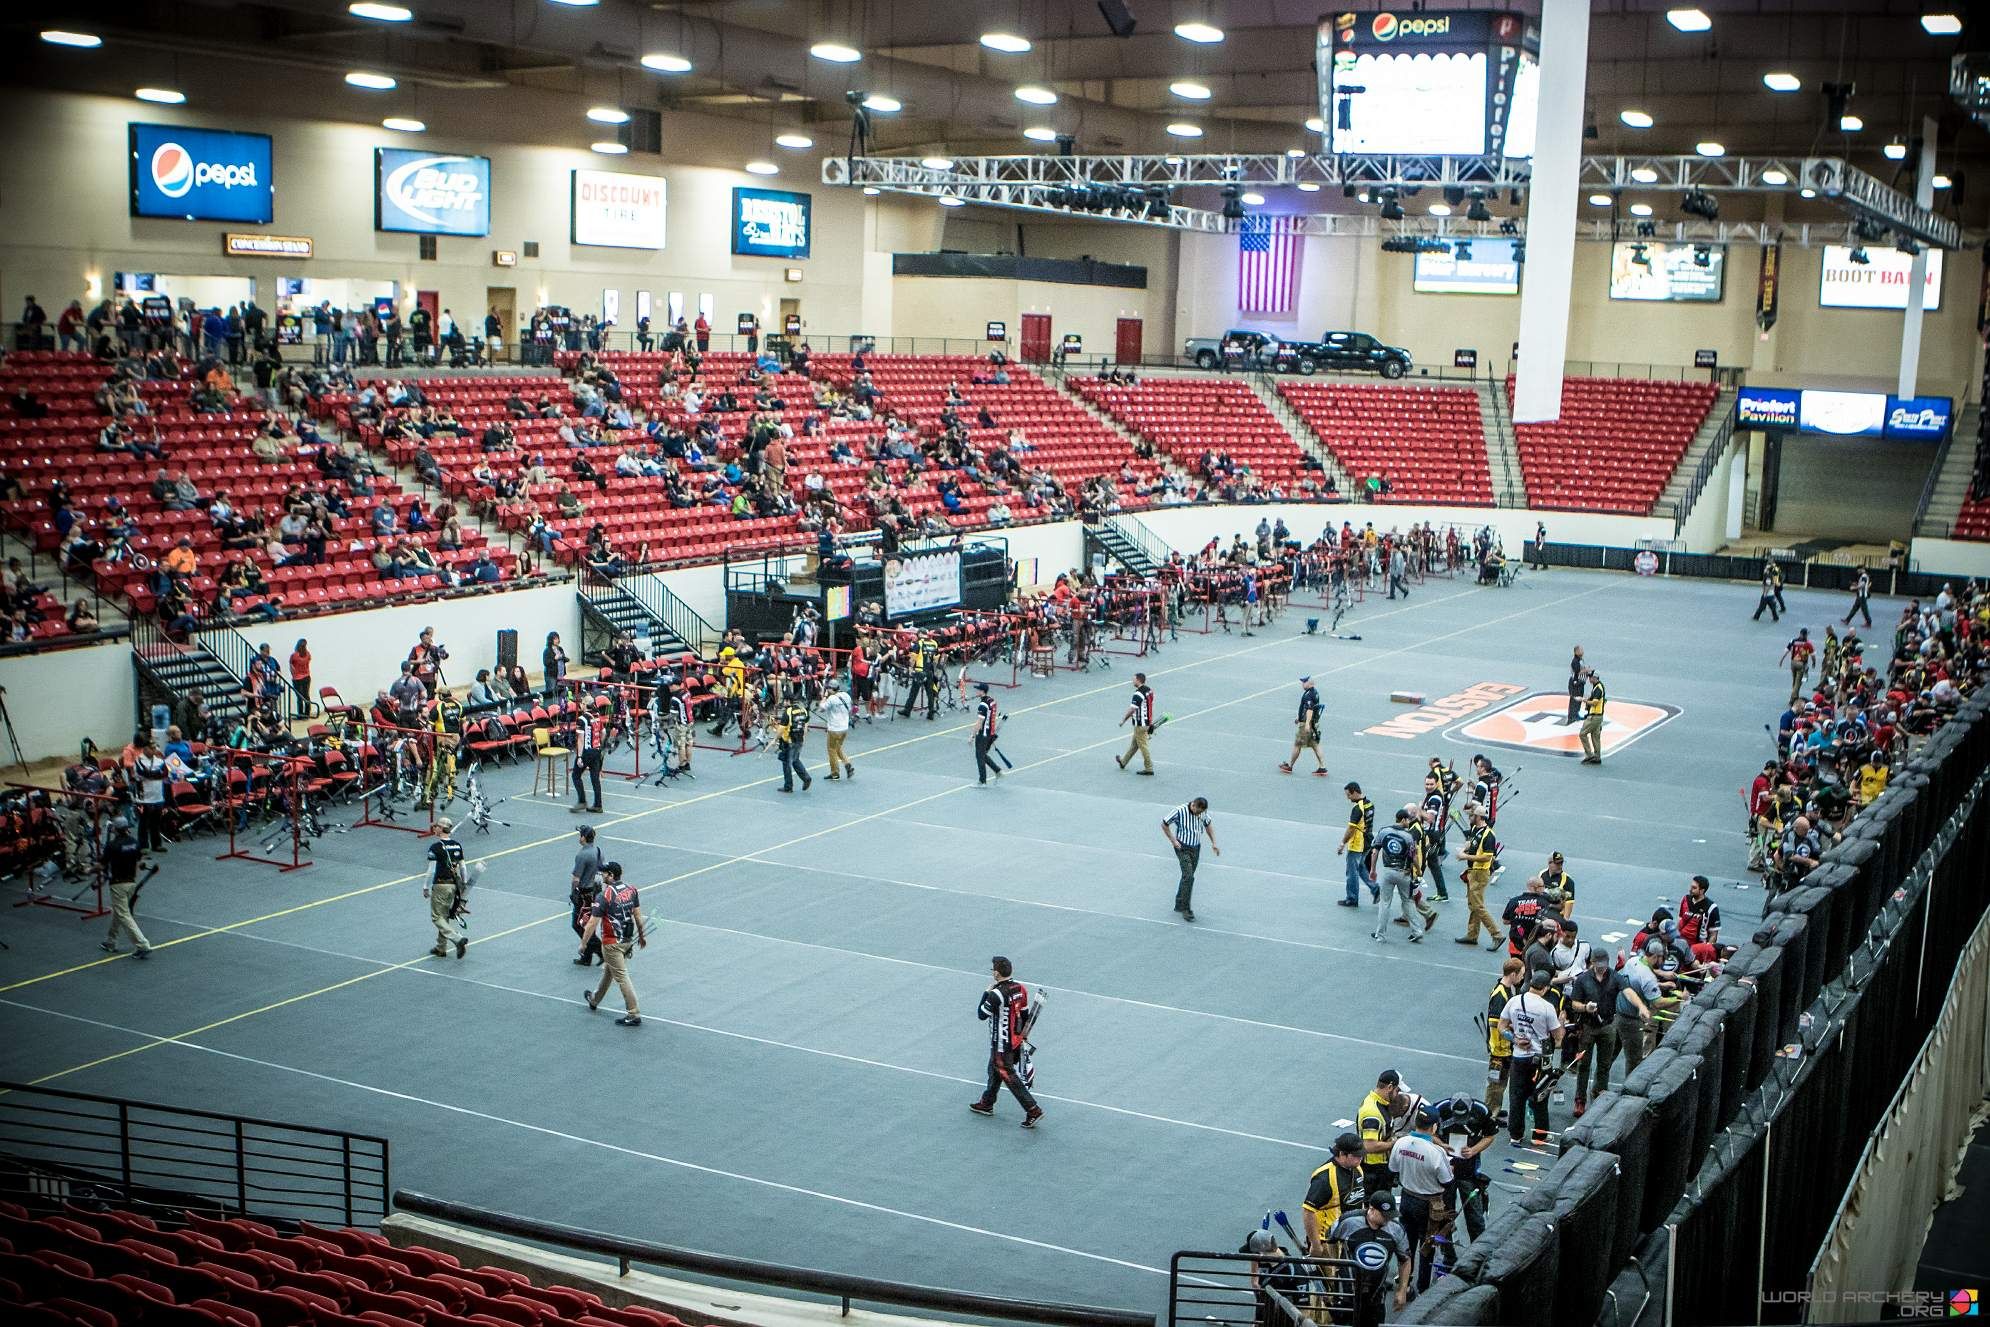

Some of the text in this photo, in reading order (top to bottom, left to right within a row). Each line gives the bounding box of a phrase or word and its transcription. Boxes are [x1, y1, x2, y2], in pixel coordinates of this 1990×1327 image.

[1399, 16, 1450, 37] pepsi
[195, 162, 258, 190] pepsi
[413, 168, 479, 193] BUD
[401, 185, 482, 211] LIGHT
[582, 183, 660, 208] DISCOUNT
[1825, 269, 1933, 286] BOOT BAN
[1740, 397, 1796, 414] Priefert
[1740, 410, 1795, 424] Pavilion
